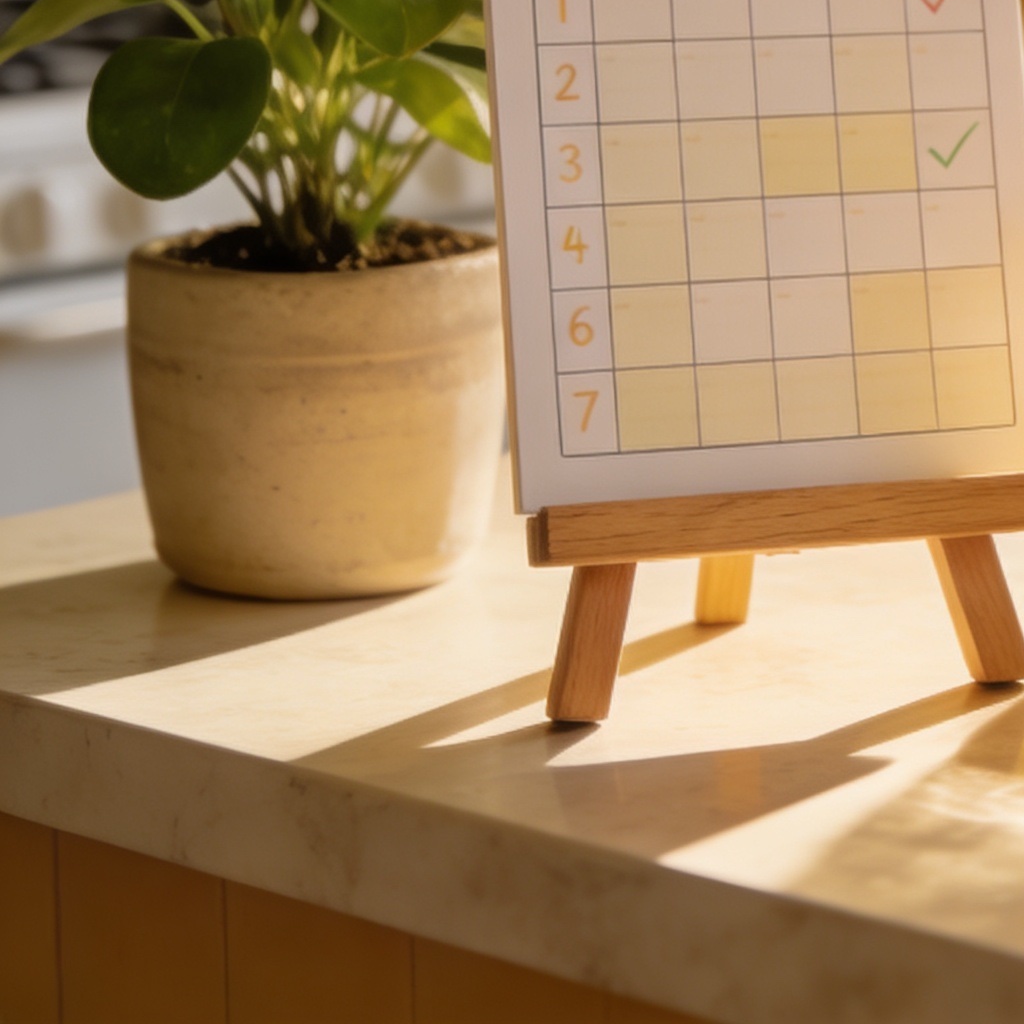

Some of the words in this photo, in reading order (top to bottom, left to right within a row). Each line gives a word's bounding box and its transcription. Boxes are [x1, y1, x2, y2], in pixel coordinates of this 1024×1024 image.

[554, 64, 580, 102] 2
[558, 144, 583, 182] 3
[563, 226, 587, 264] 4
[569, 306, 594, 346] 6
[573, 391, 600, 432] 7
